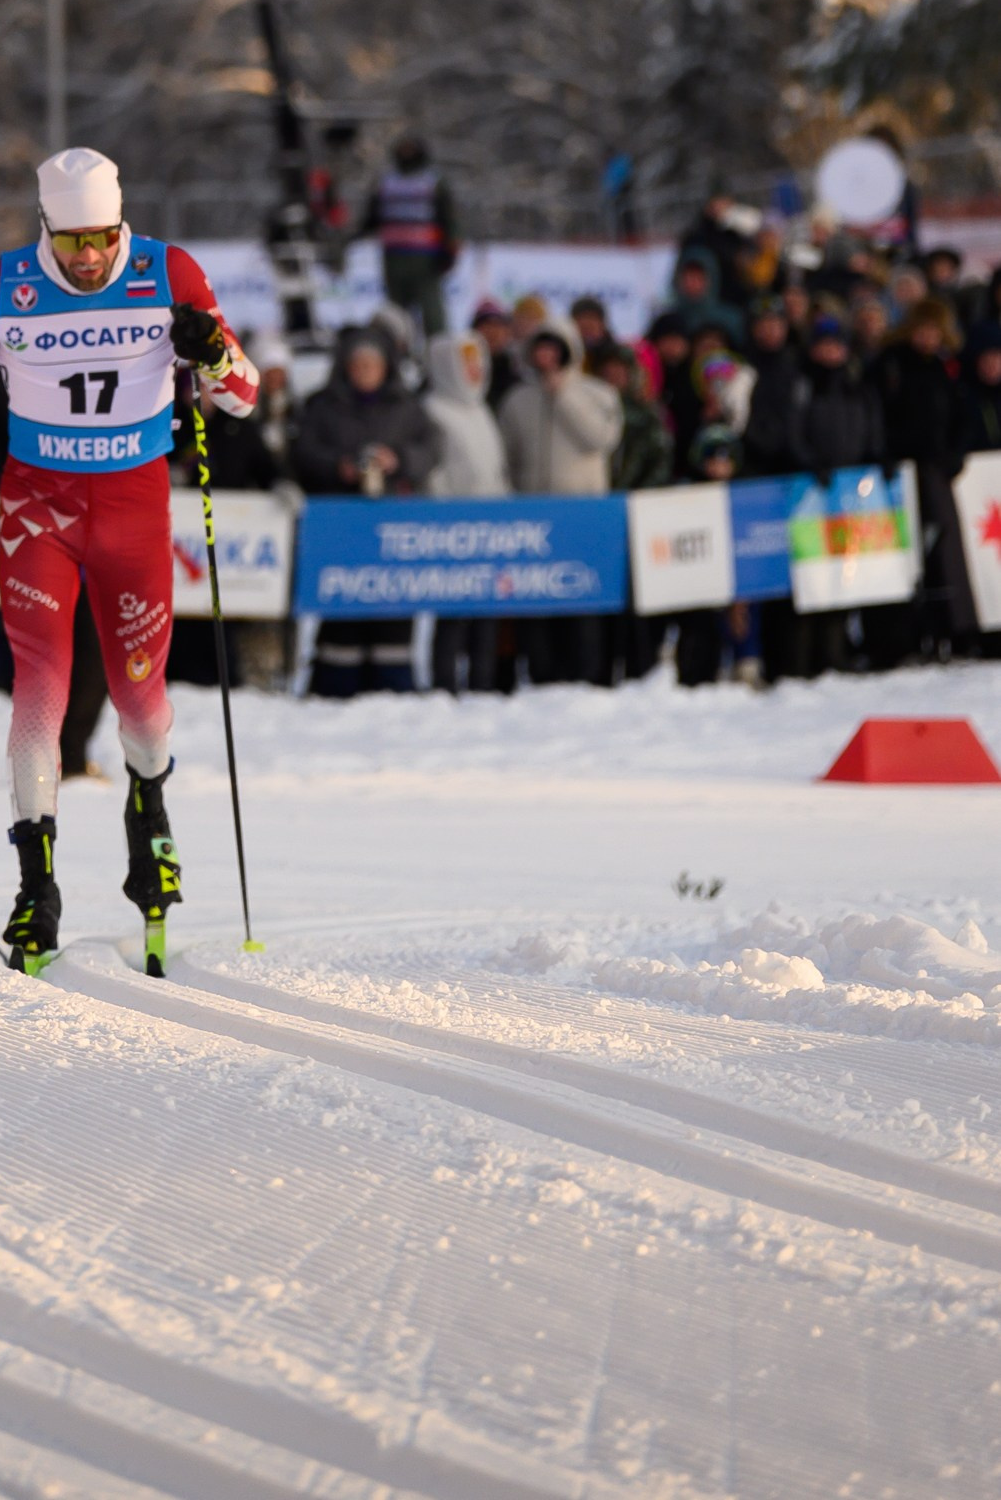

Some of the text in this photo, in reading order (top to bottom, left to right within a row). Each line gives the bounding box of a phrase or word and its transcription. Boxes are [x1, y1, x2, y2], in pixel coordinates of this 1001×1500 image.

[35, 325, 164, 351] ФОСАГРО
[59, 370, 119, 415] 17
[38, 431, 142, 462] ИЖЕВСК
[376, 520, 552, 560] ТЕХНОПАРК
[5, 576, 60, 612] ЛУКОЙЛ
[115, 601, 166, 637] ФОСАГРО
